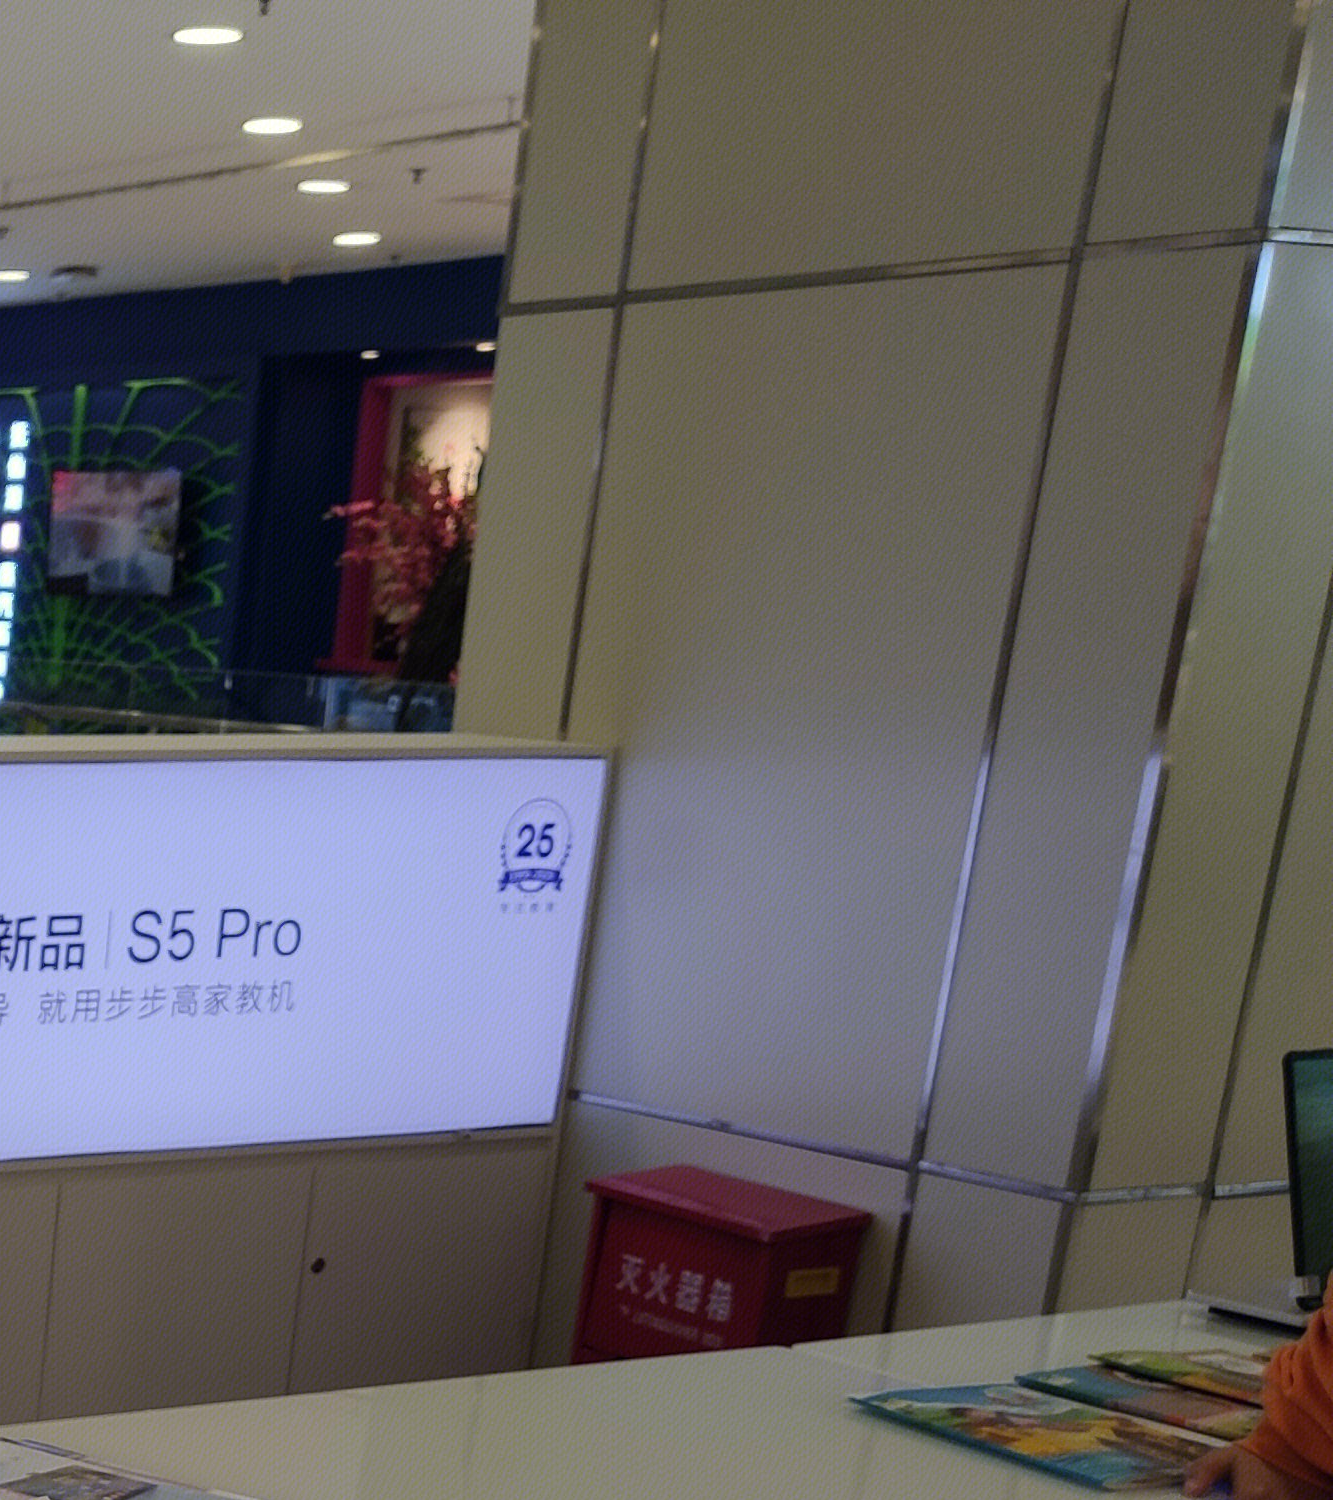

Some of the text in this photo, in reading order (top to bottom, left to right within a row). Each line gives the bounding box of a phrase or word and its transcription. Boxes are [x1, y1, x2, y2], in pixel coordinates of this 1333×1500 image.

[516, 823, 556, 858] 25
[127, 909, 196, 964] S5
[215, 907, 302, 959] Pro
[36, 979, 296, 1026] 就用步步高家教机
[615, 1253, 734, 1323] 灭火器箱
